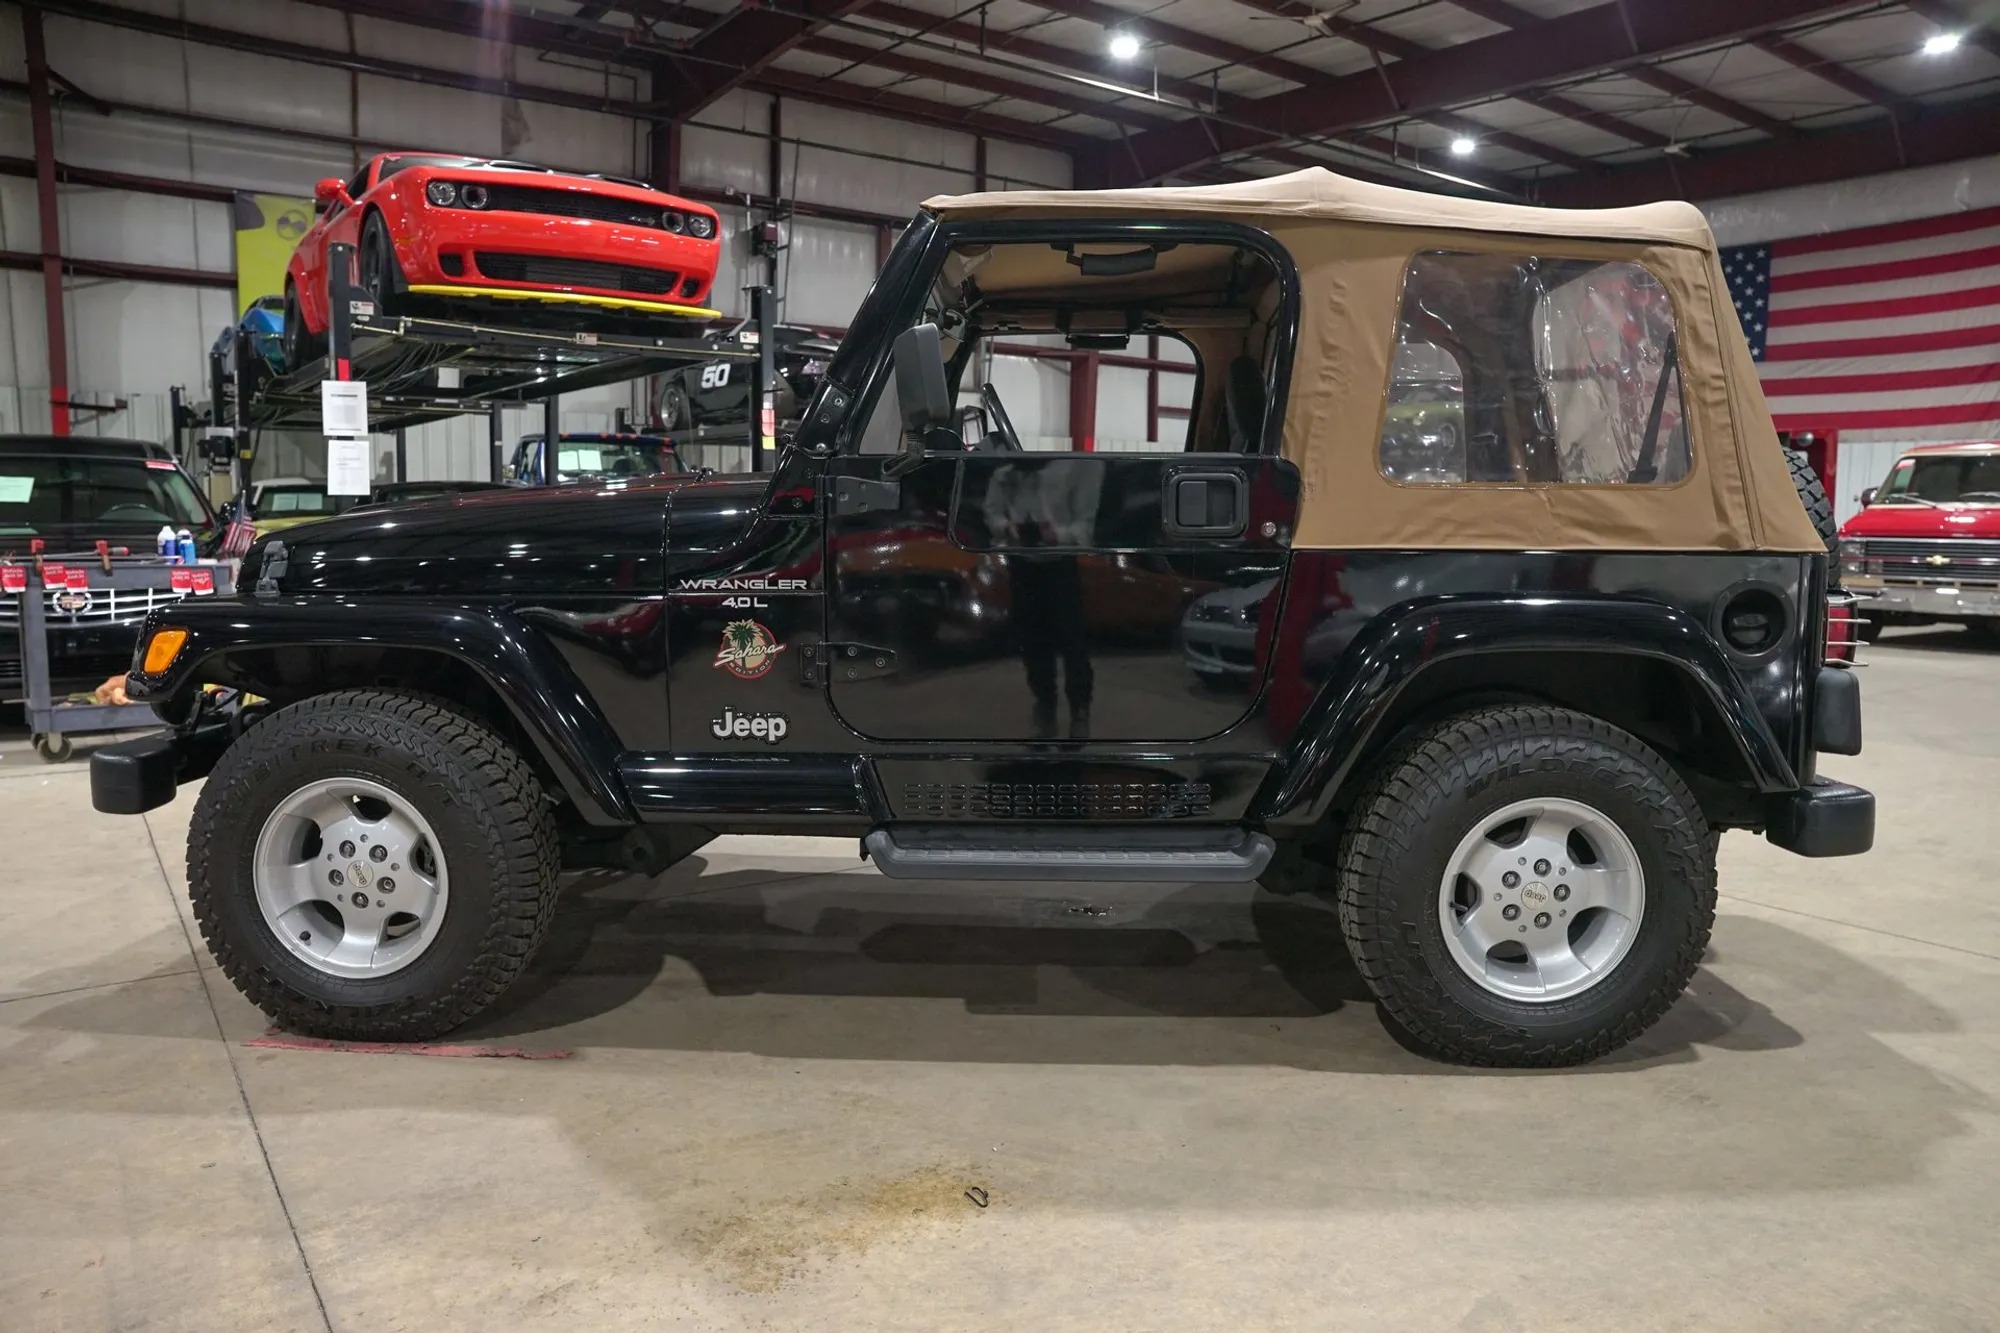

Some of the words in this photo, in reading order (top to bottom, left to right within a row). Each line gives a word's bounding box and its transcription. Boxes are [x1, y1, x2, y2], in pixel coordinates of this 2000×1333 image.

[701, 363, 731, 389] 50
[680, 579, 807, 590] WRANGLER
[713, 641, 786, 667] Sahara
[729, 659, 771, 676] EDITION
[713, 708, 788, 742] Jeep
